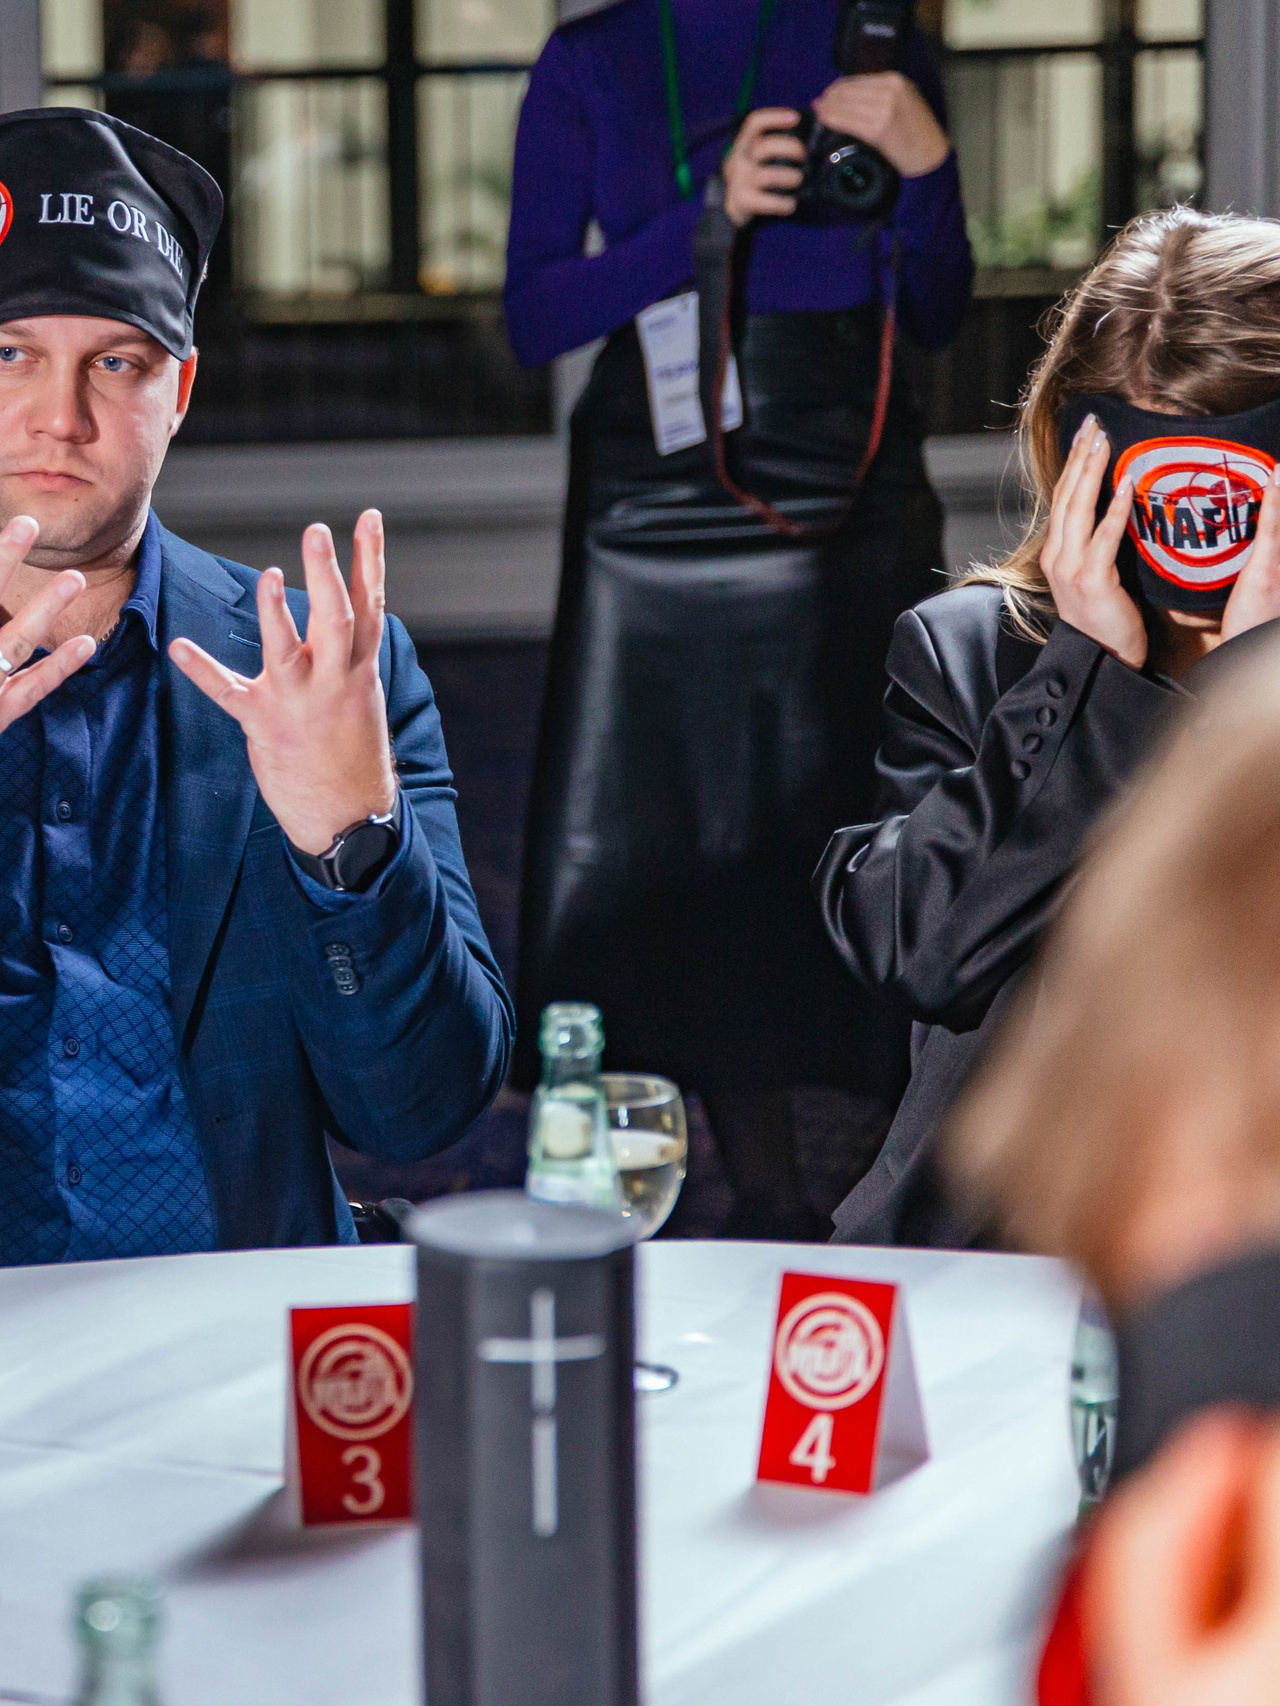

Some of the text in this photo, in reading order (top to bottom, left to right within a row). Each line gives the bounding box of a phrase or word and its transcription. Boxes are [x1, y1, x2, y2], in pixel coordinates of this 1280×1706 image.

[38, 193, 184, 280] LIE OR DIE
[341, 1444, 386, 1516] 3
[788, 1412, 837, 1484] 4
